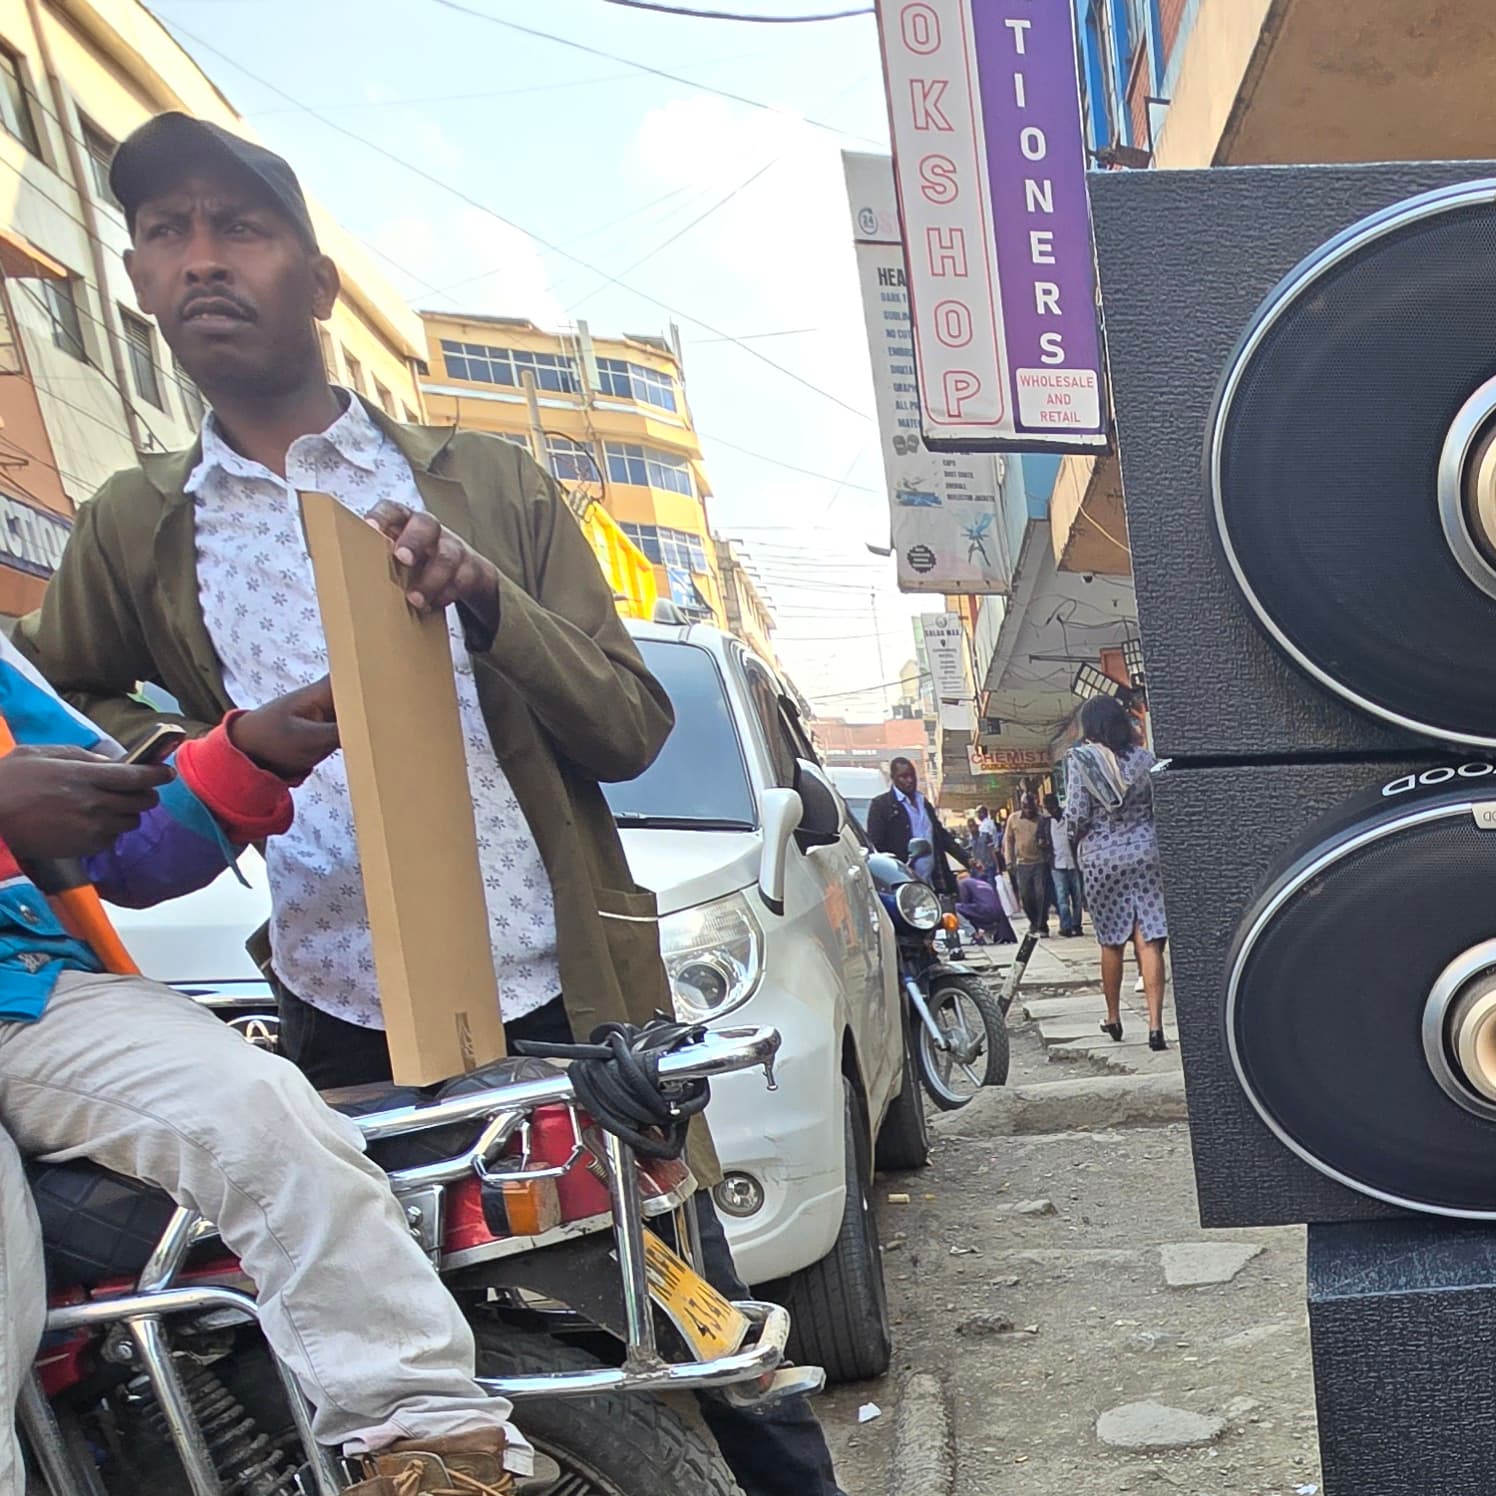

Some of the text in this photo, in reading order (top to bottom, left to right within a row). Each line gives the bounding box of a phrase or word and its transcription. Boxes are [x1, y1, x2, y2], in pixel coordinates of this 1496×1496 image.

[1004, 18, 1066, 366] TIONERS
[1020, 375, 1095, 389] WHOLESALE
[1046, 393, 1072, 406] AND
[1039, 410, 1082, 423] RETAIL
